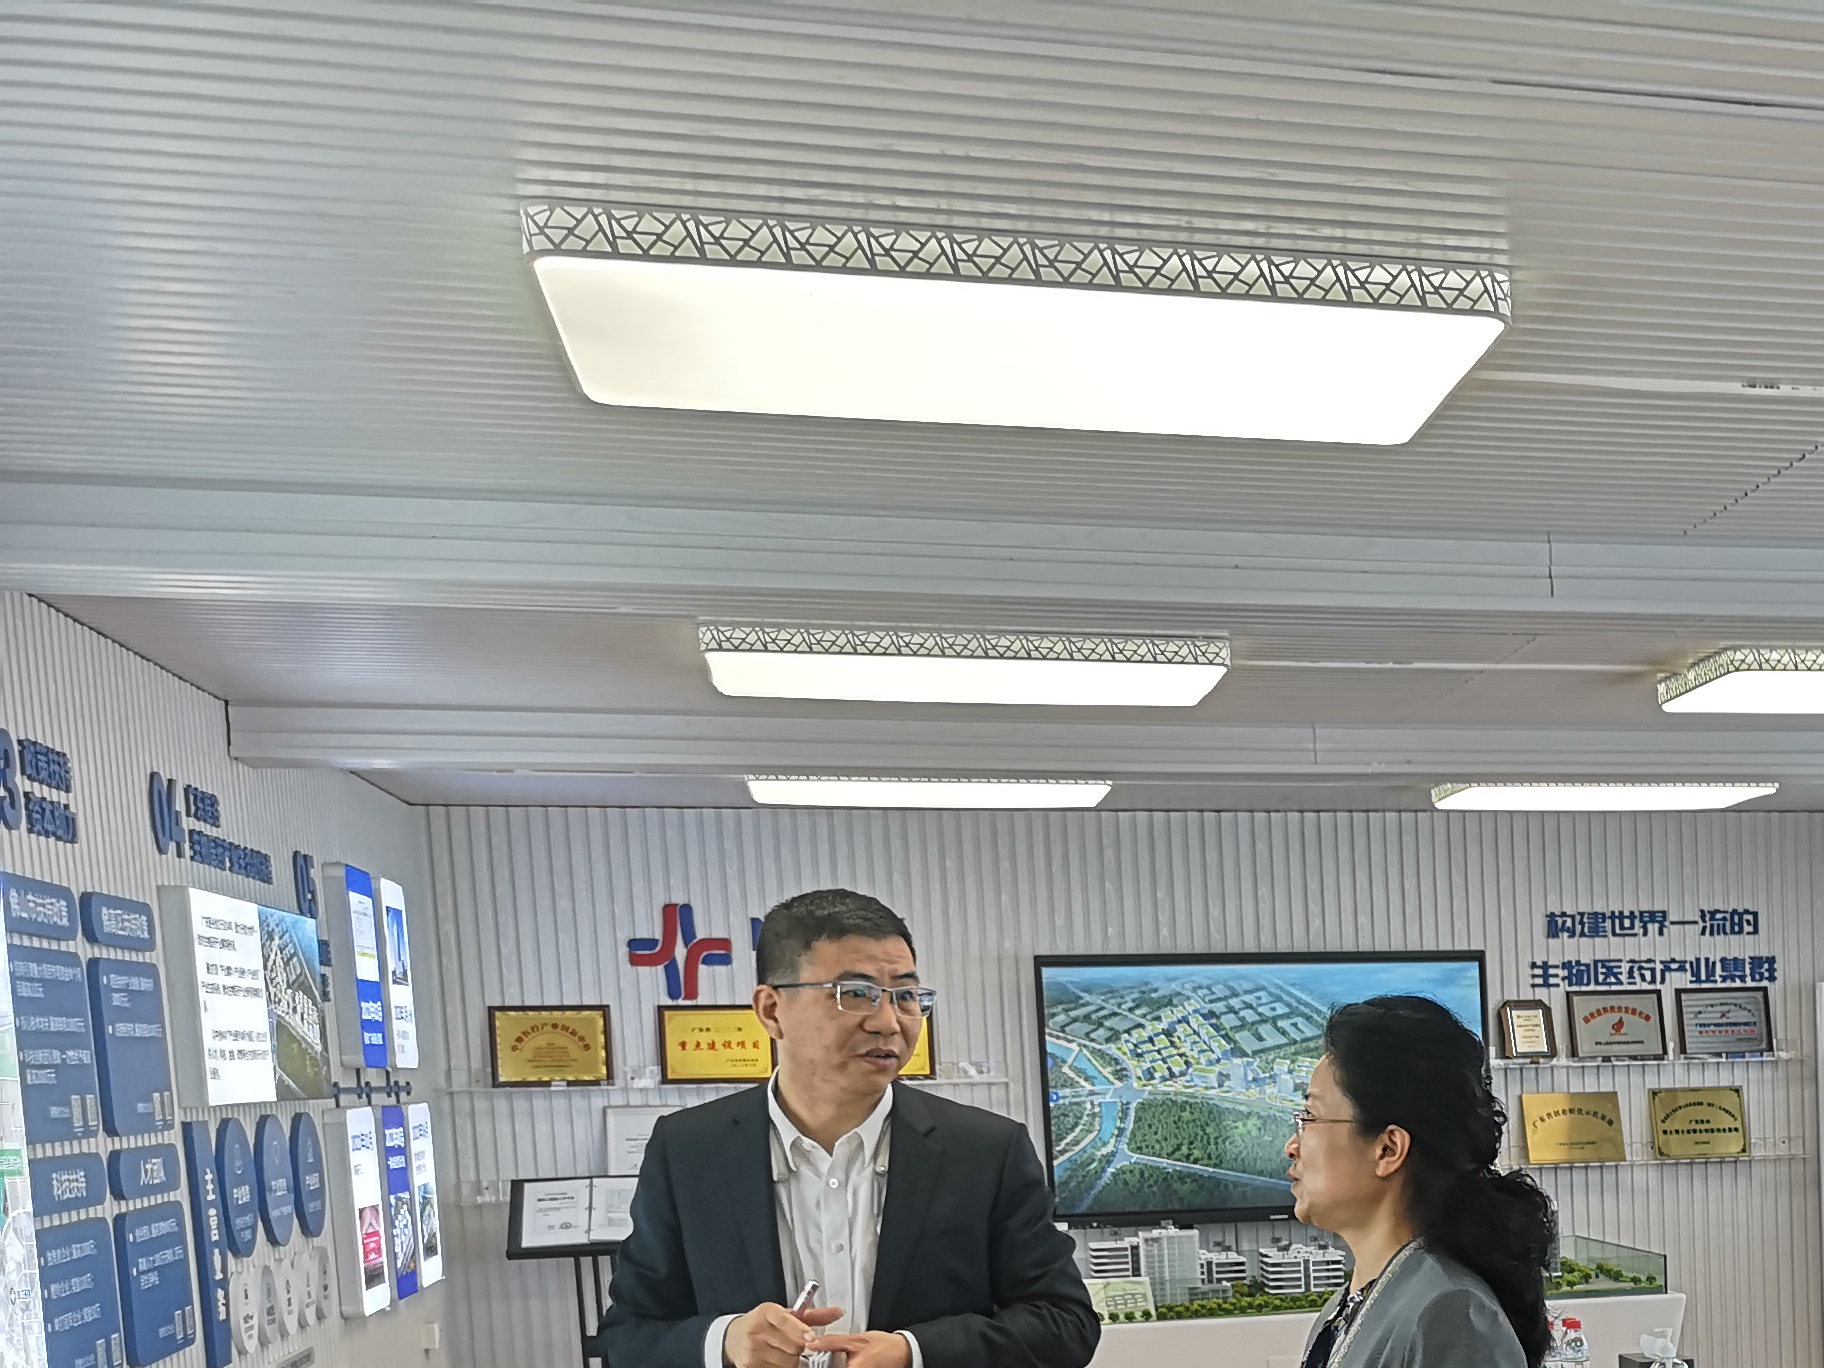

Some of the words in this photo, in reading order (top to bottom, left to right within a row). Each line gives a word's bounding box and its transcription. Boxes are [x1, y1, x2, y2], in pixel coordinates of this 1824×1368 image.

[149, 771, 187, 859] 04
[1545, 908, 1760, 940] 构建世界一流的
[1530, 955, 1779, 988] 生物医药产业集群
